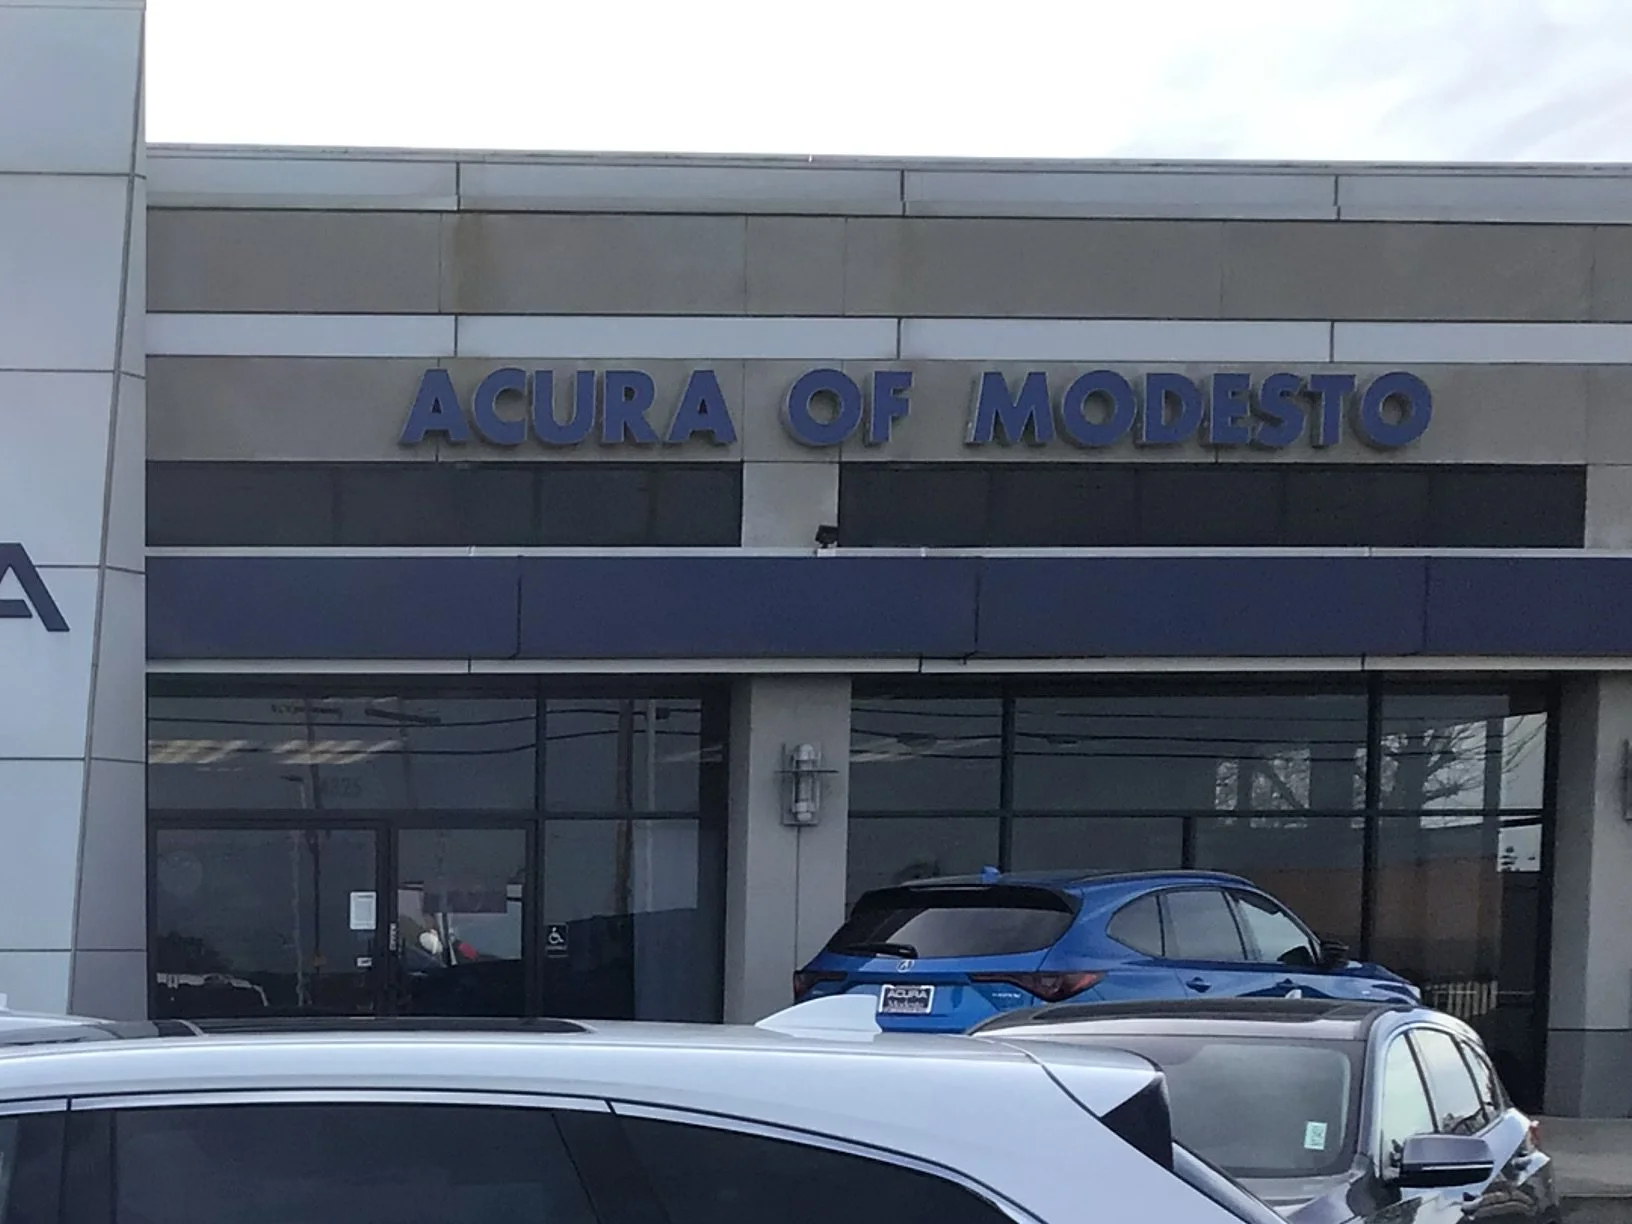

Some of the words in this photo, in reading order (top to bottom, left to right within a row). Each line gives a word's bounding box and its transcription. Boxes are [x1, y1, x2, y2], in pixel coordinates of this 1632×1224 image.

[398, 367, 738, 448] ACURA
[781, 369, 914, 448] OF
[962, 369, 1434, 450] MODESTO
[887, 989, 928, 998] ACURA
